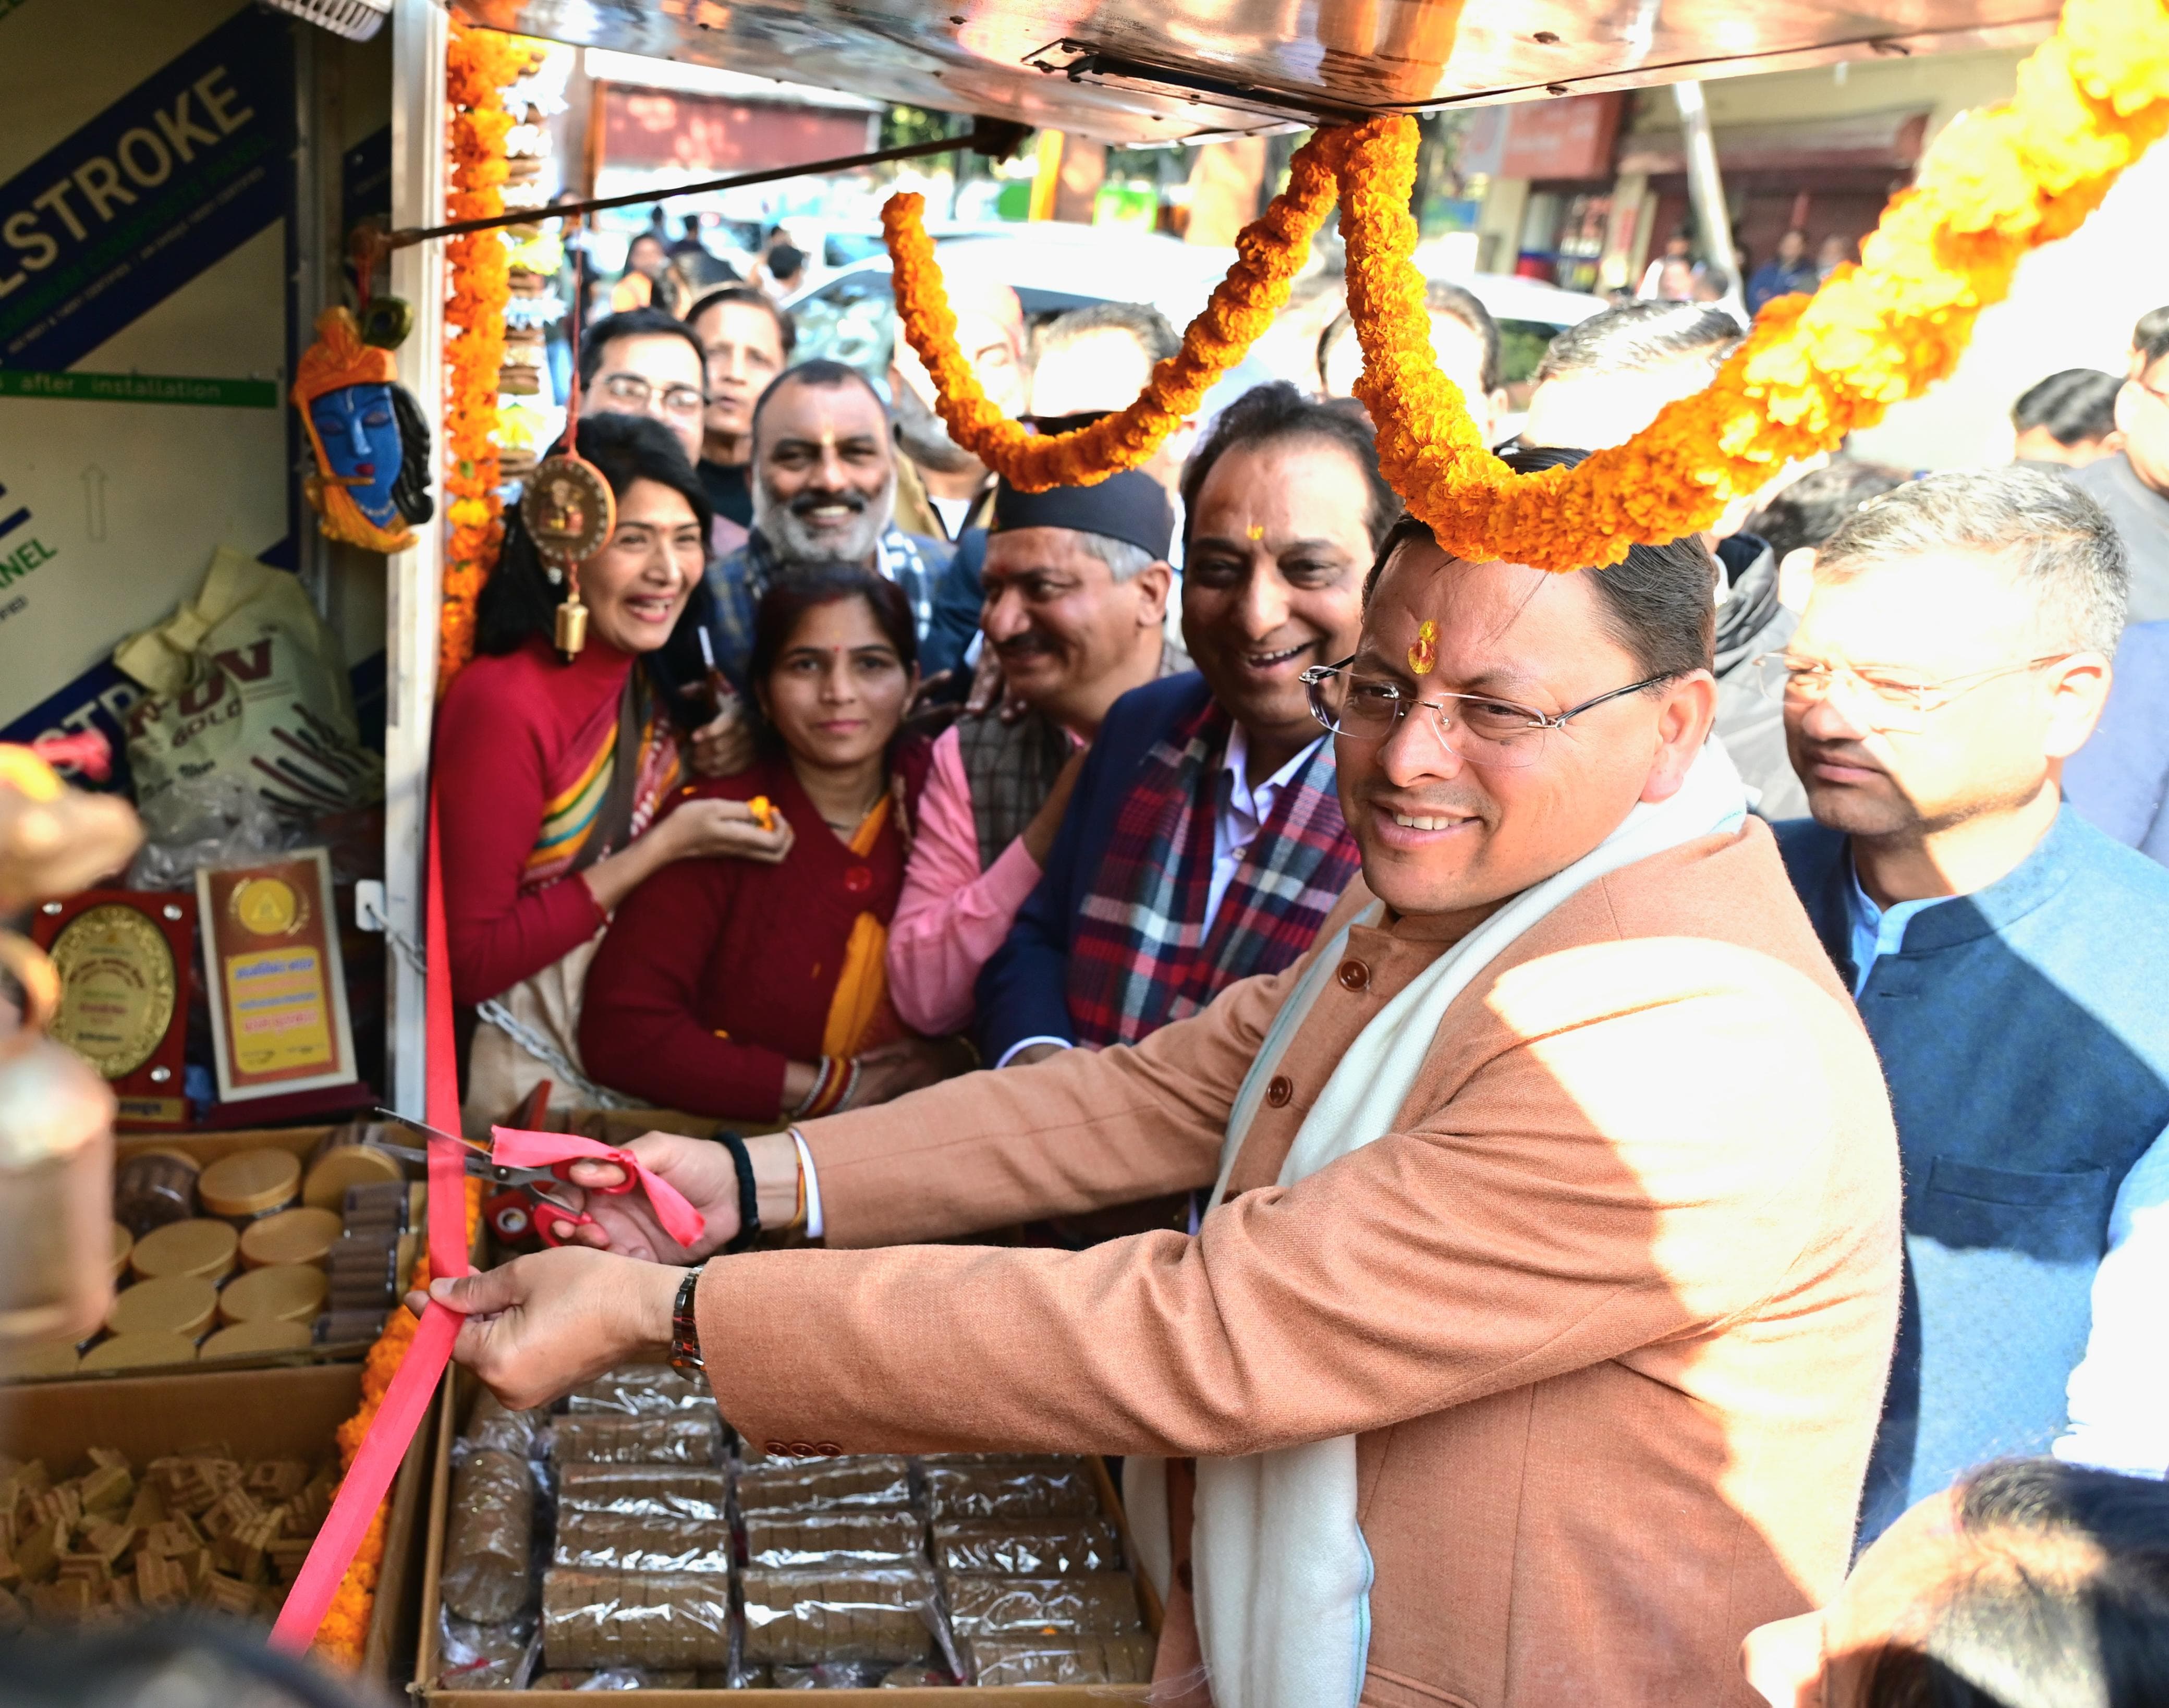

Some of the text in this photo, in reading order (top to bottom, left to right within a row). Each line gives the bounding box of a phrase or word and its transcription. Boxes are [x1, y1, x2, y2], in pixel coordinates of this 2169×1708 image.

[20, 373, 75, 394] after
[91, 376, 221, 400] installation
[0, 538, 57, 589] NEL
[172, 698, 242, 748] GOLD
